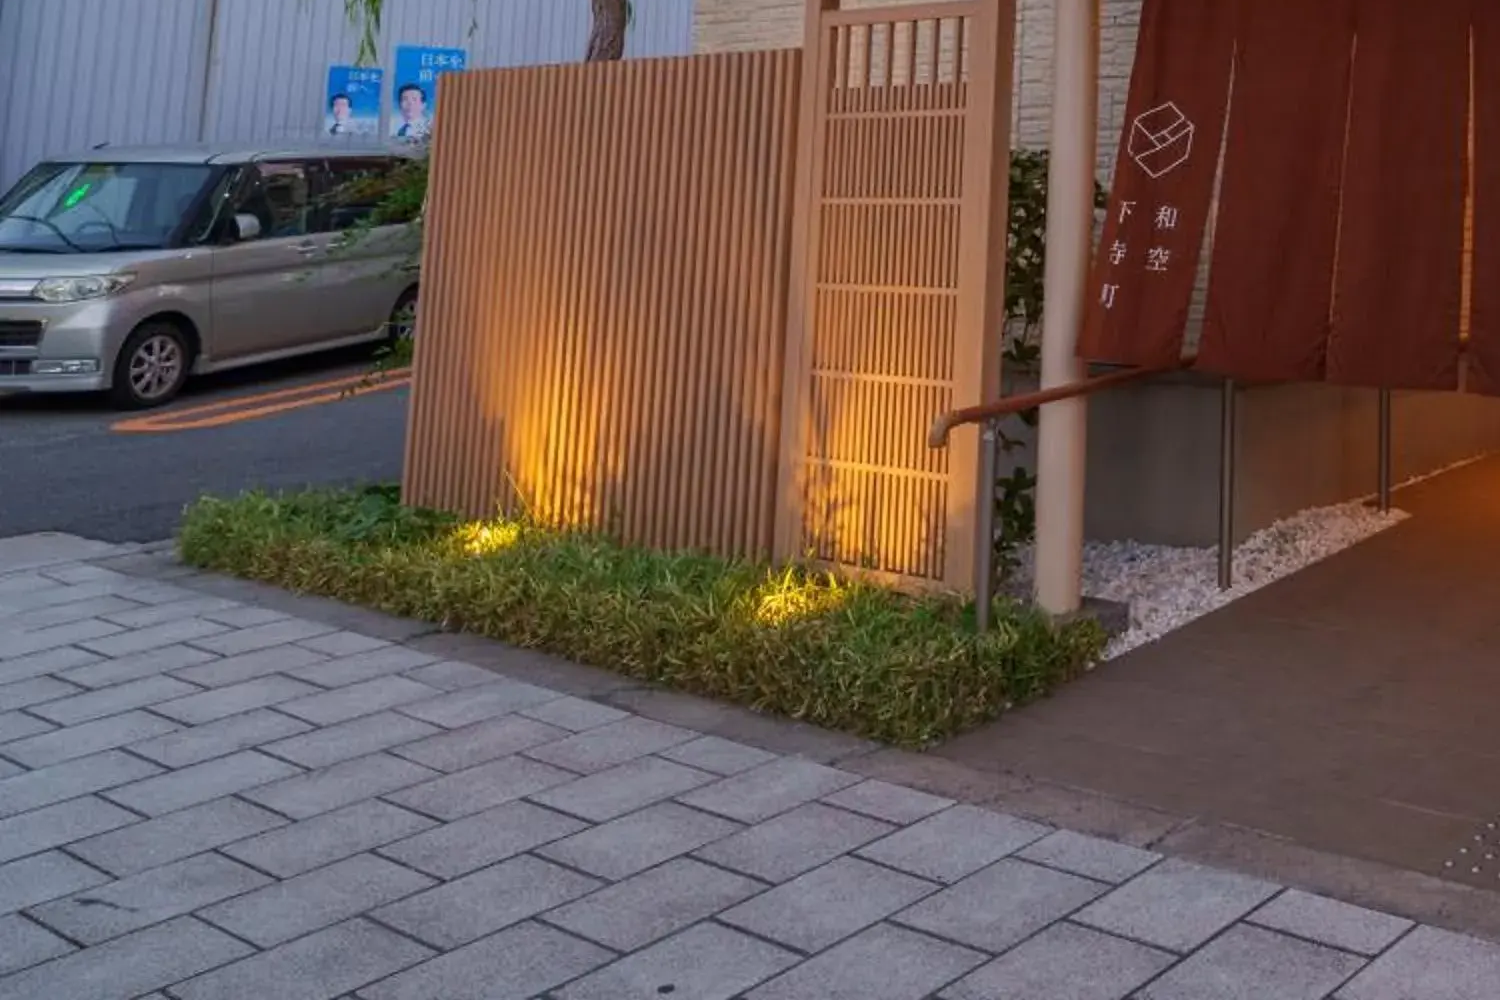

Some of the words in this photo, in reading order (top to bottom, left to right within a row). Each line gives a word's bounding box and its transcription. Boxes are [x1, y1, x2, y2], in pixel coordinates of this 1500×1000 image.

[1101, 201, 1136, 309] 下寺町
[1145, 205, 1178, 271] 和空
